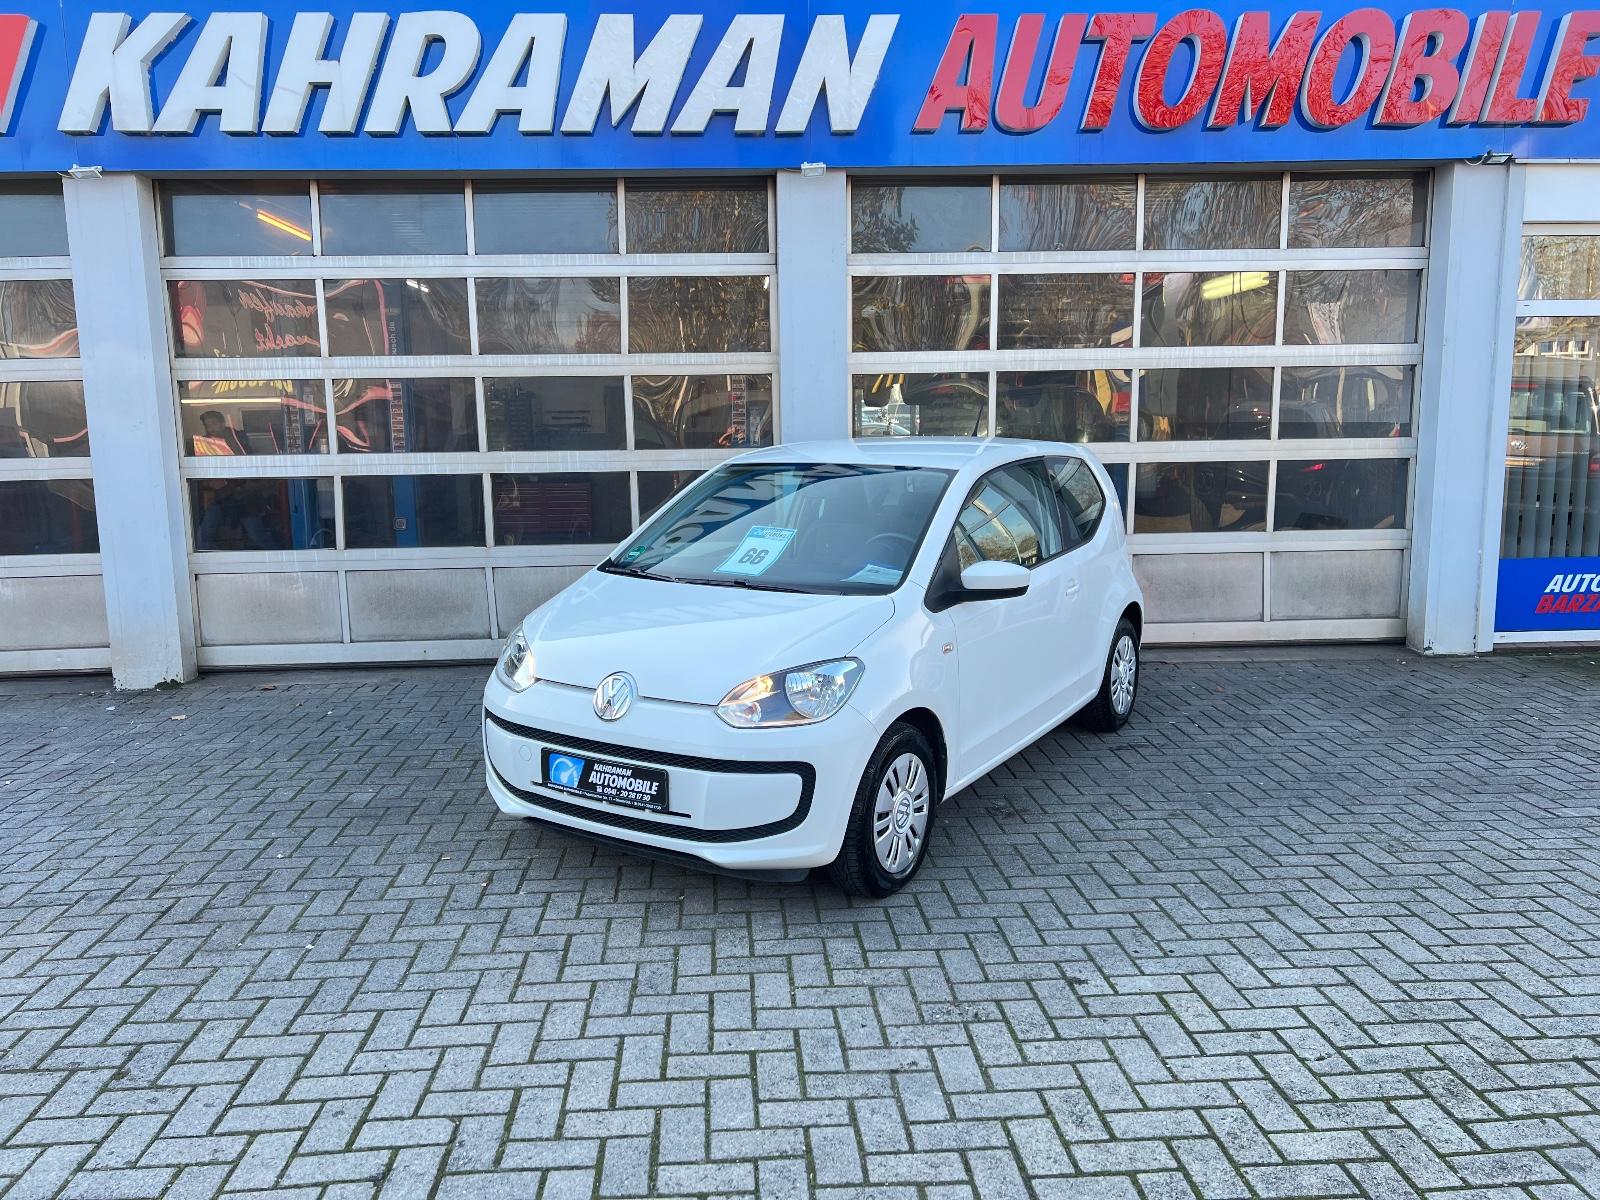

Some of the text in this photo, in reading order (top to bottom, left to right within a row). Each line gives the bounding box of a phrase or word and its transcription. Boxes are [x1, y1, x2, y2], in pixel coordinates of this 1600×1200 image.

[57, 8, 1600, 135] KAHRAMAN AUTOMOBILE
[738, 547, 770, 565] 66
[594, 675, 633, 720] VW
[589, 770, 660, 795] AUTOMOBILE
[593, 763, 632, 777] KAHRAMAN
